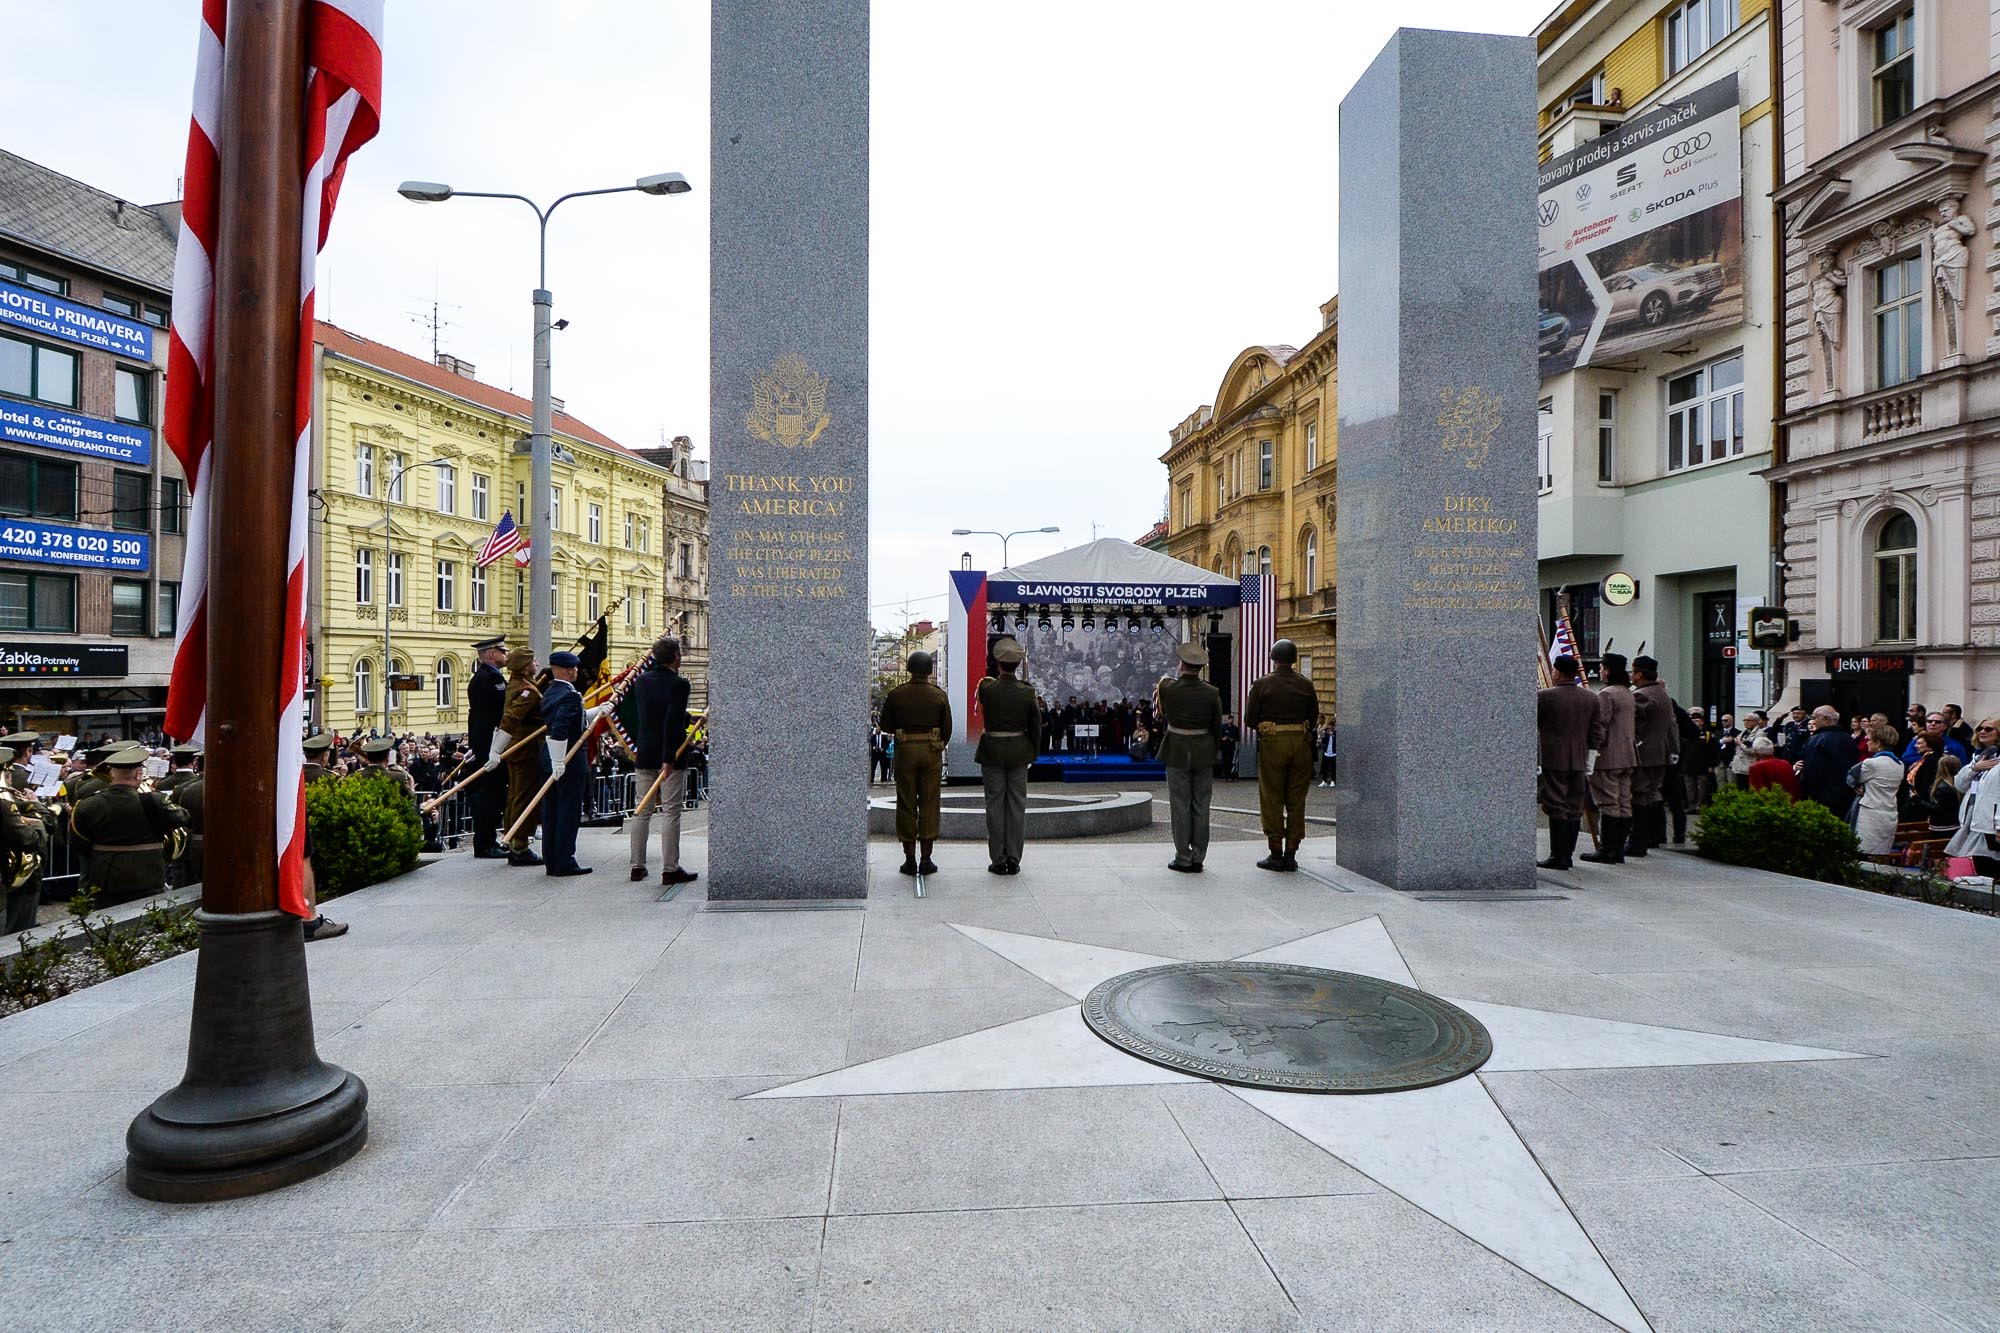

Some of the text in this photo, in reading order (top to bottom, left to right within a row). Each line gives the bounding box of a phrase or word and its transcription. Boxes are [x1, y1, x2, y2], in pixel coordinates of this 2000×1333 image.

[1576, 143, 1611, 172] prodej
[1613, 142, 1620, 153] a
[1622, 123, 1654, 149] servis
[1656, 102, 1697, 133] značek
[1663, 159, 1692, 178] Audi
[1609, 181, 1644, 200] SEAT
[1645, 180, 1719, 214] ŠKODA Plus
[54, 306, 145, 344] PRIMAVERA
[81, 331, 109, 346] PLZEŇ
[124, 344, 131, 352] 4
[131, 346, 145, 356] km
[32, 416, 45, 428] &
[48, 419, 103, 440] Congress
[106, 432, 142, 447] centre
[5, 426, 132, 458] WWW.PRIMAVERAHOTEL.CZ
[725, 474, 853, 493] THANK YOU
[738, 499, 845, 516] AMERICA!
[1423, 517, 1517, 533] AMERIKO!
[0, 527, 141, 554] 420 378 020 500
[734, 530, 844, 542] ON MAY 6TH 1945
[50, 550, 104, 563] KONFERENCE
[111, 556, 141, 565] SVATBY
[727, 548, 752, 560] THE
[755, 548, 785, 561] CITY
[789, 548, 806, 560] OF
[737, 566, 842, 579] WAS LIBERATED
[731, 584, 747, 597] BY
[752, 584, 778, 597] THE
[810, 584, 847, 598] ARMY
[1017, 584, 1207, 598] SLAVNOSTI SVOBODY PLZEŇ
[43, 656, 79, 667] Potraviny
[1837, 657, 1868, 672] Jekyll
[1157, 1053, 1231, 1077] DIVISION
